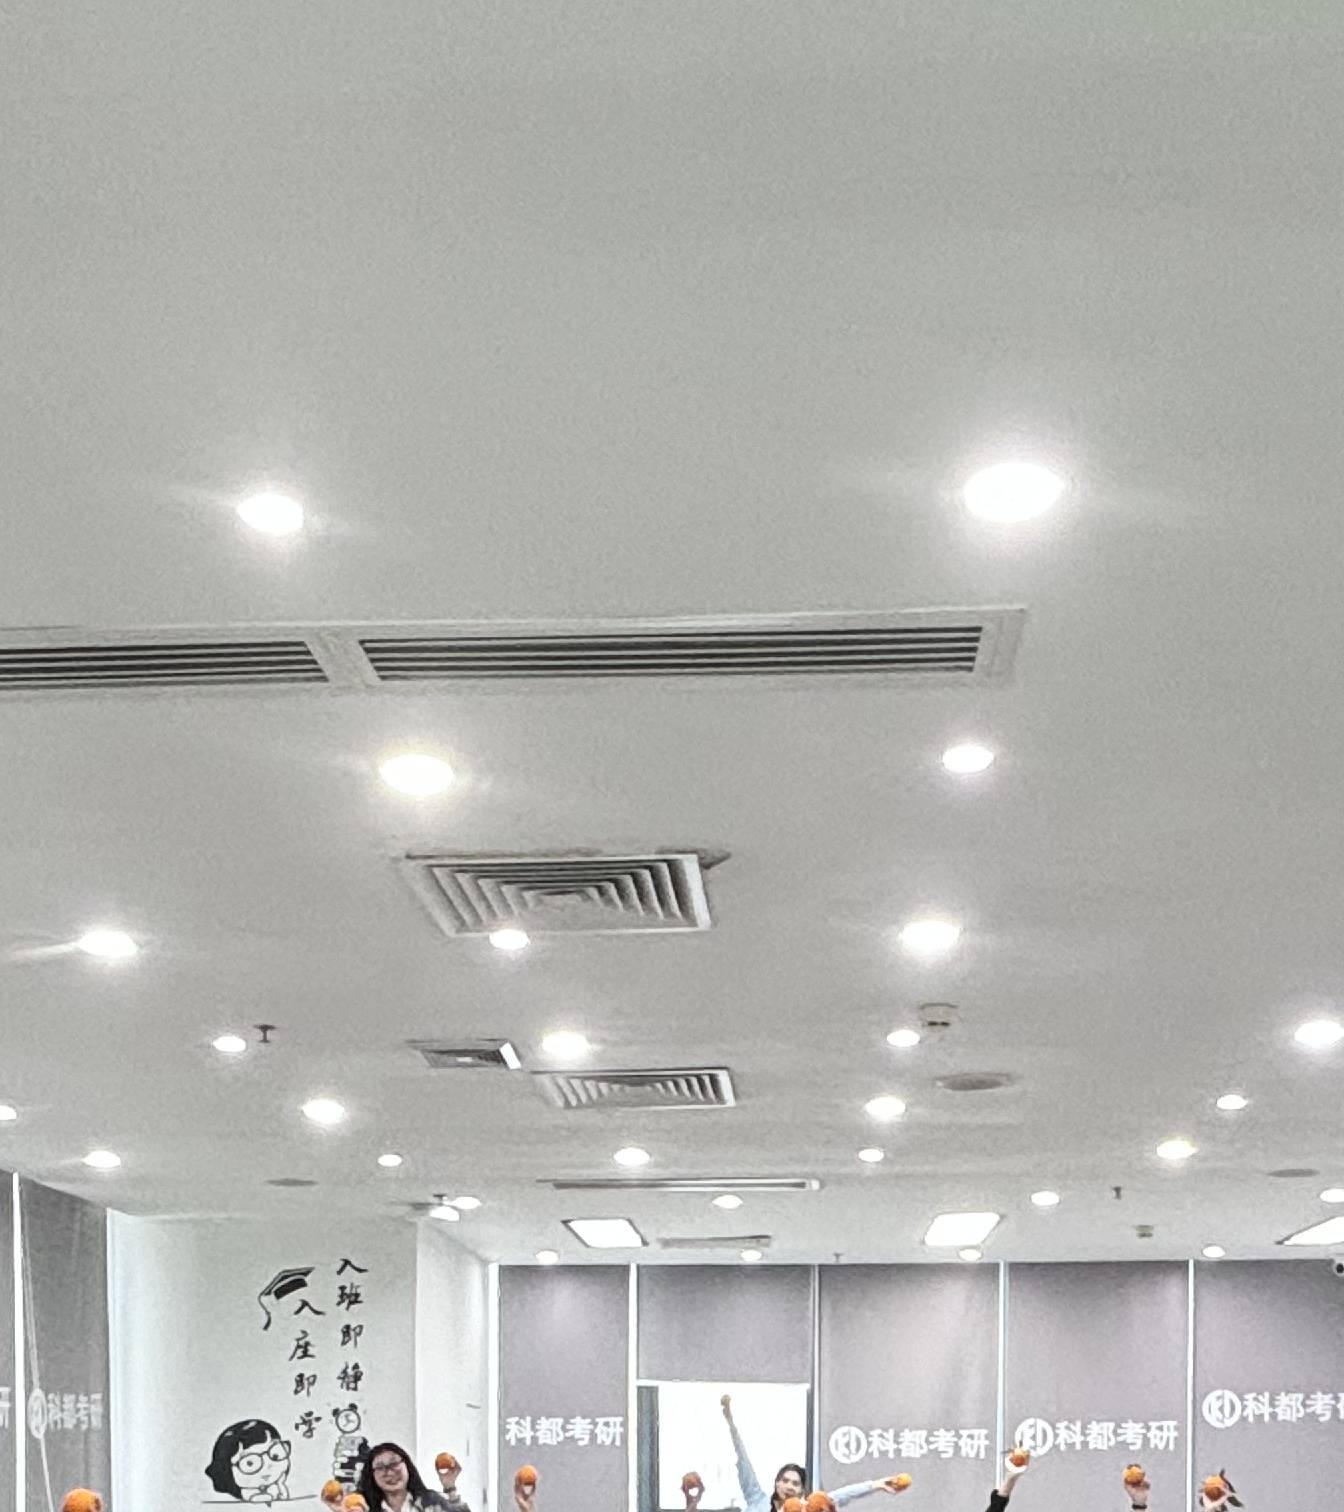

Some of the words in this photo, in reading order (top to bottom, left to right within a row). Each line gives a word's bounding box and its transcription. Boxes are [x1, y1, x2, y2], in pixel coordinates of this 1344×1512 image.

[335, 1257, 369, 1393] 入班即静
[288, 1298, 326, 1439] 入座即学
[505, 1415, 624, 1447] 科都考研
[868, 1427, 990, 1460] 科都考研
[1055, 1418, 1179, 1452] 科都考研
